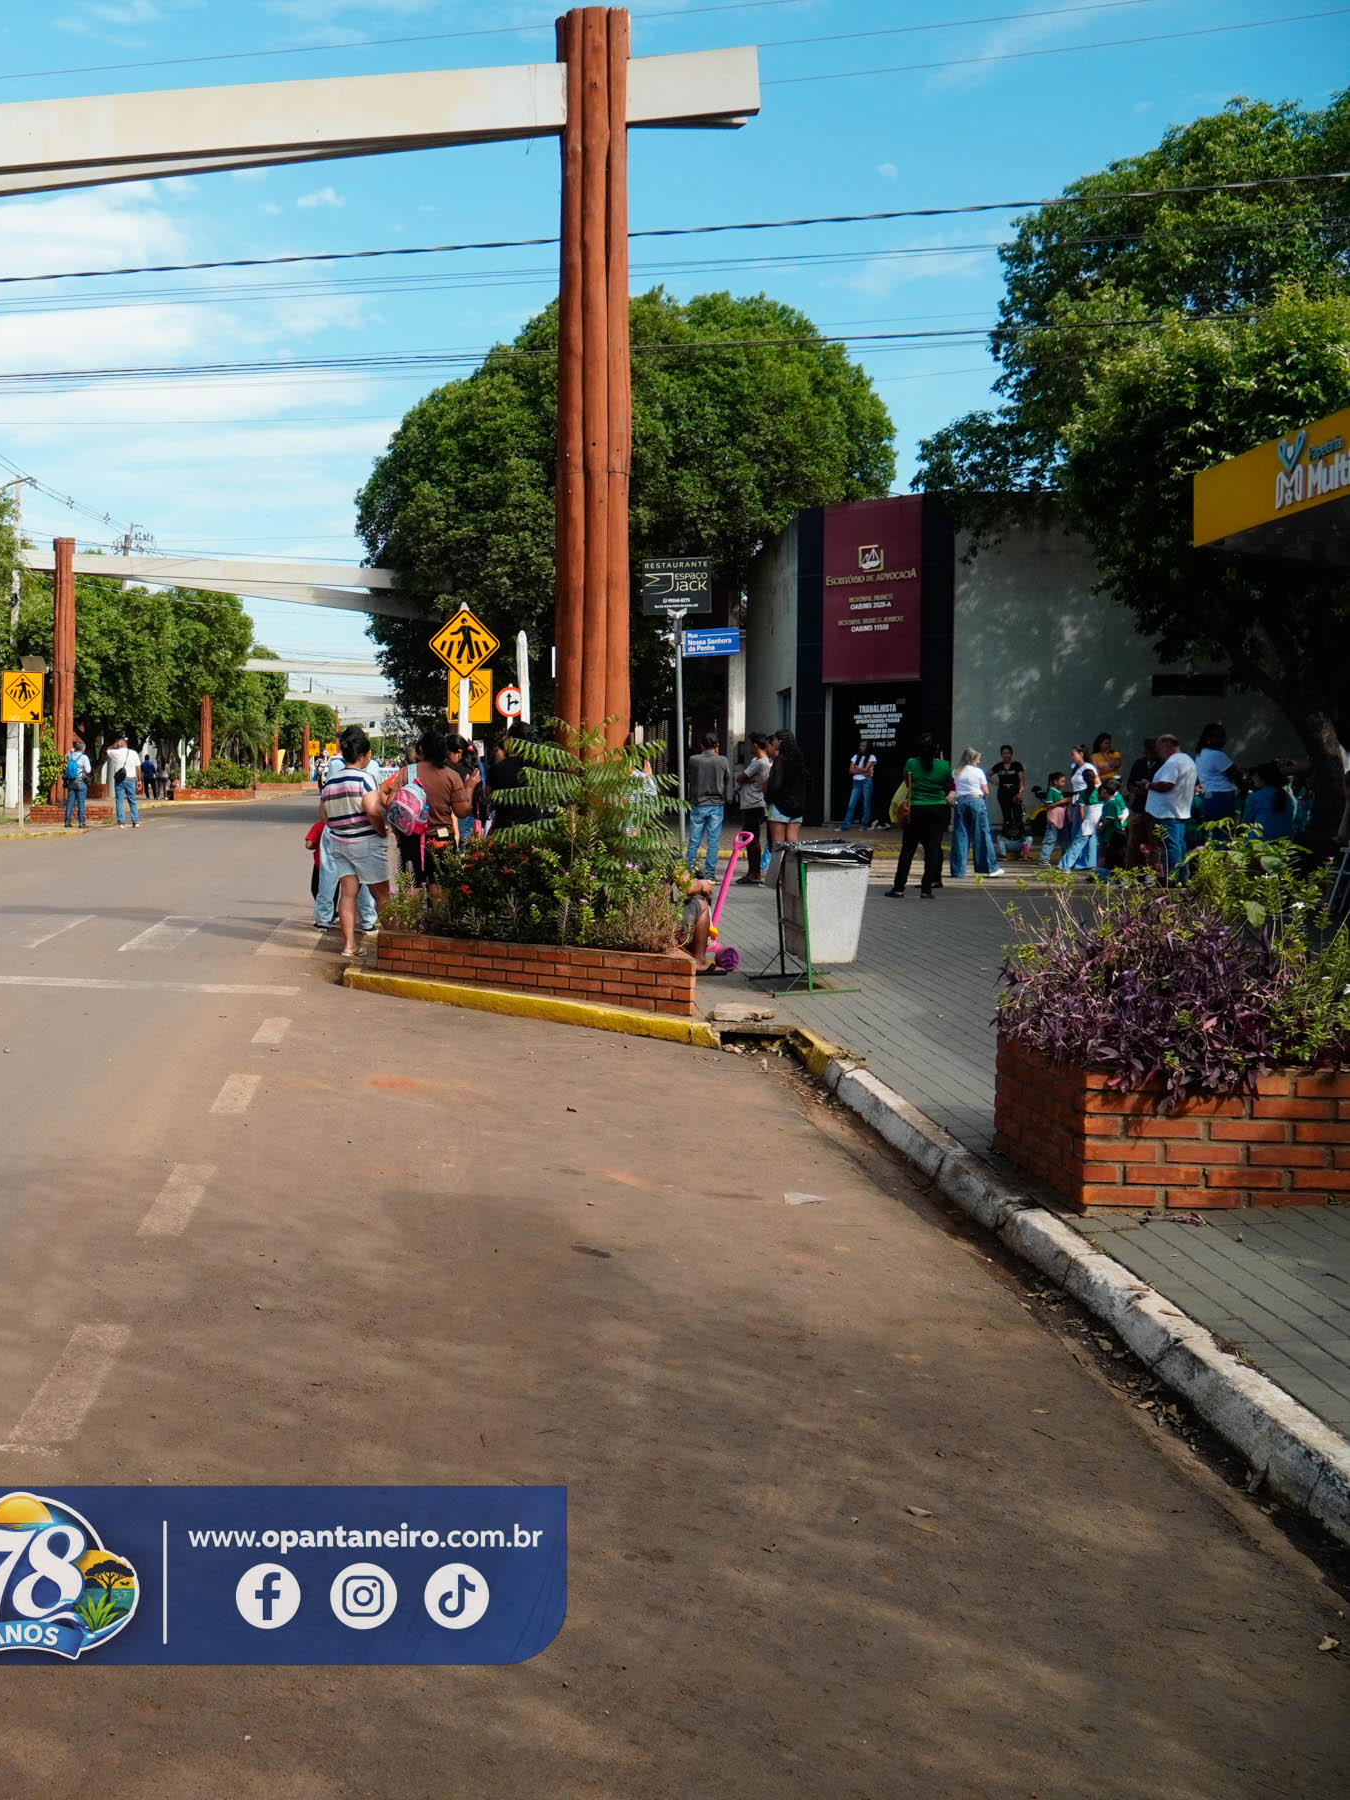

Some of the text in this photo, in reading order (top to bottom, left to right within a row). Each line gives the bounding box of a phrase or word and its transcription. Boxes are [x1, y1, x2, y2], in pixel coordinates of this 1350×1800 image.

[644, 561, 708, 569] RESTAURANTE
[826, 575, 865, 586] ESCRITÓRIO
[876, 568, 917, 581] ADVOCACIA
[859, 704, 897, 713] TRABALHISTA
